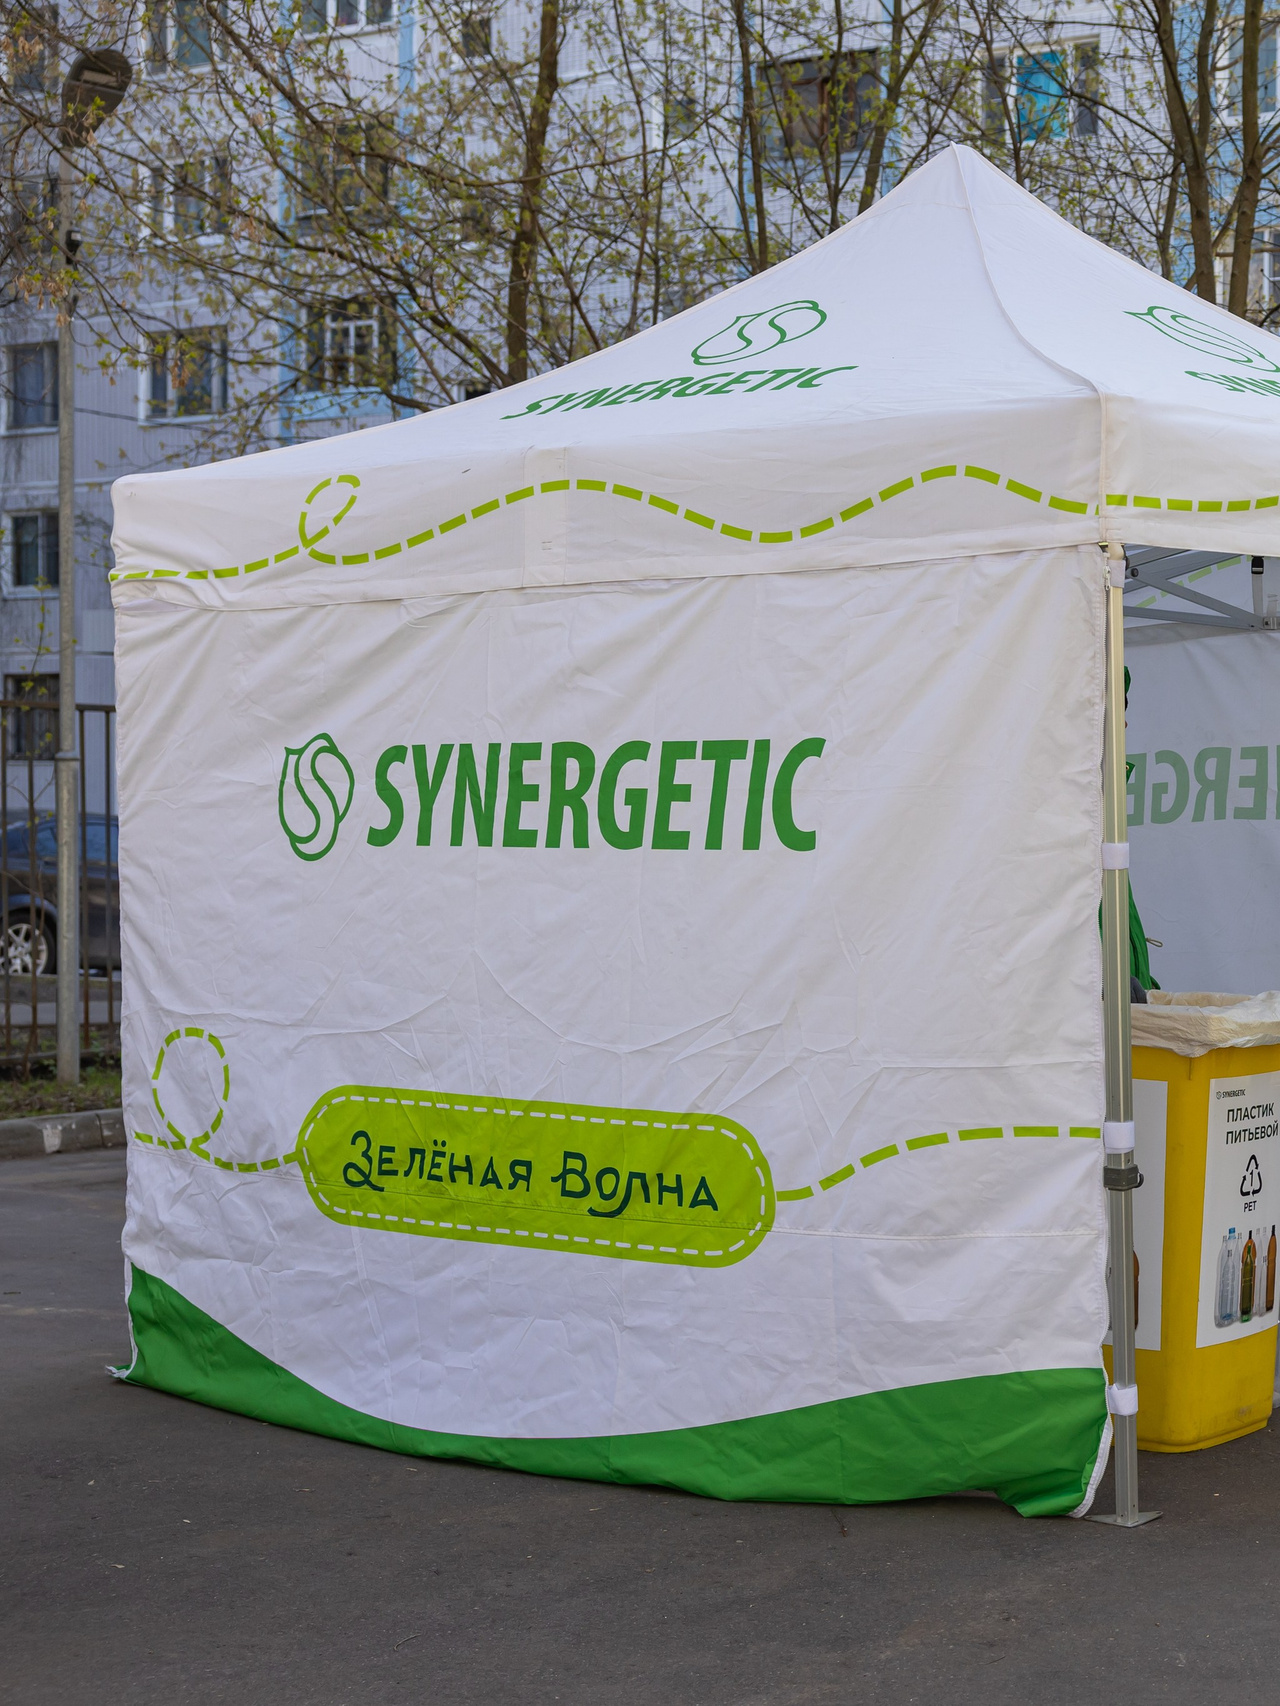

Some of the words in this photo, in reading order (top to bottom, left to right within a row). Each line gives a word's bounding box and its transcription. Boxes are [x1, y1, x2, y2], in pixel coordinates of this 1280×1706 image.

[500, 366, 859, 420] SYNERGETIC
[366, 737, 827, 852] SYNERGETIC
[1222, 1089, 1246, 1099] SYNERGETIC
[1227, 1102, 1275, 1123] ПЛАСТИК
[1226, 1120, 1279, 1145] ПИТЬЕВОЙ
